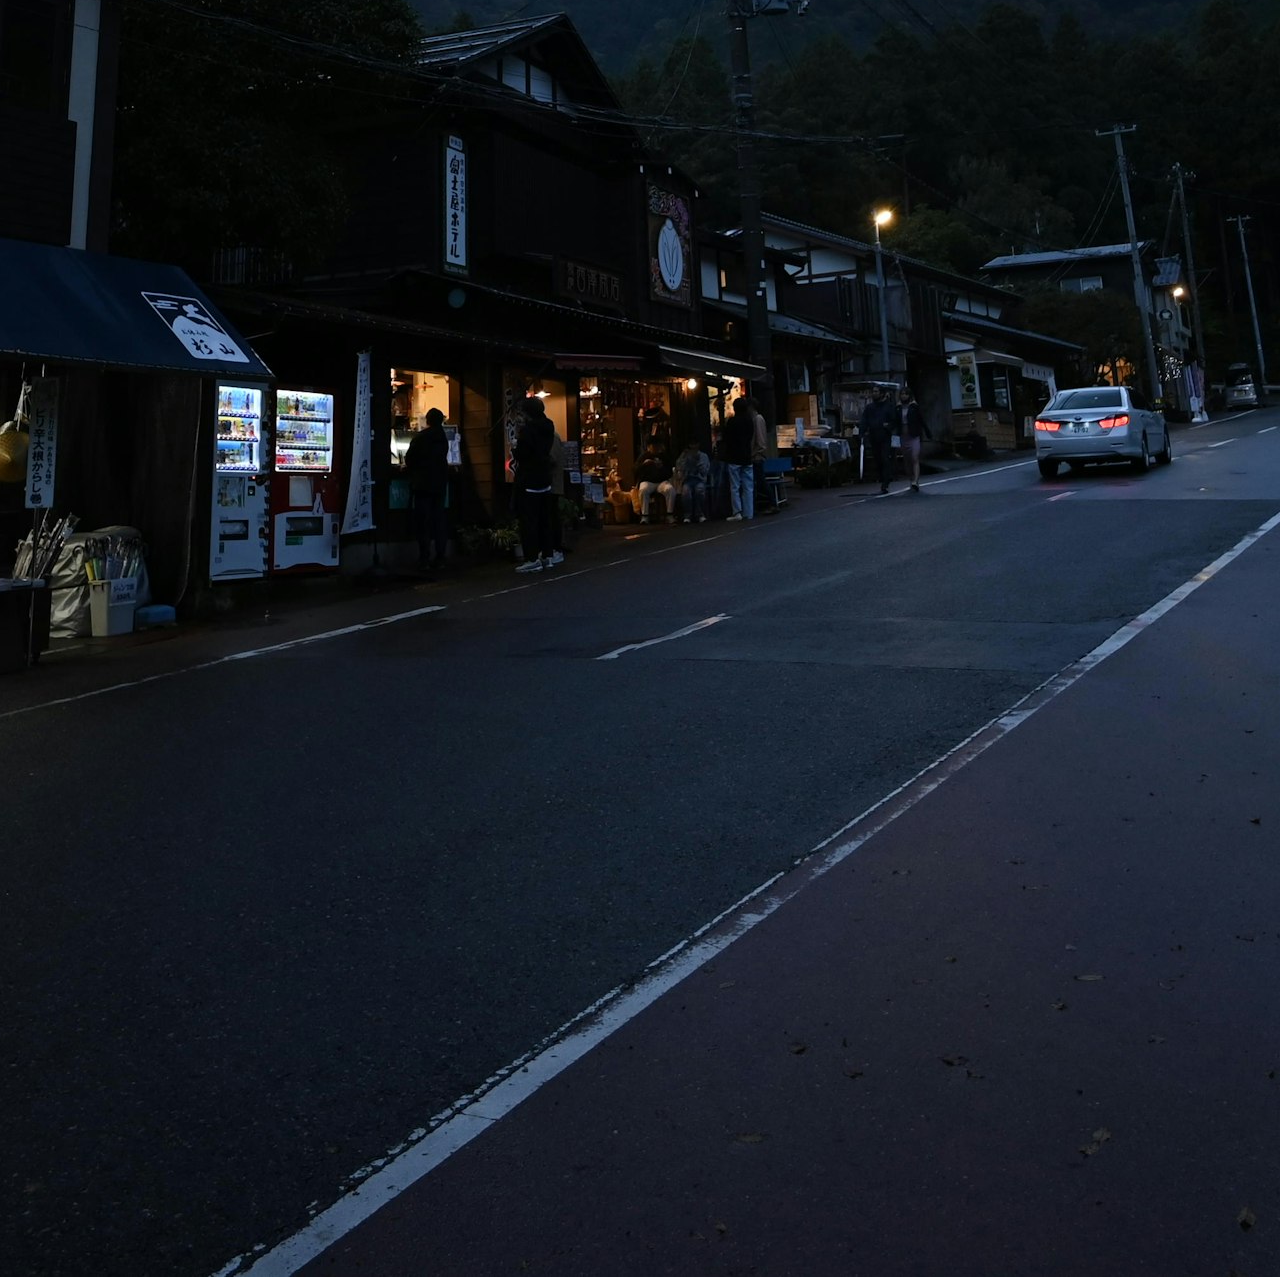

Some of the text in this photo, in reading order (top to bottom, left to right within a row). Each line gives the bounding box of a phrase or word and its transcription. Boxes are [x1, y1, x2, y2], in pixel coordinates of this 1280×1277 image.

[449, 154, 460, 258] 富士屋ホテル
[190, 338, 236, 356] 杉山
